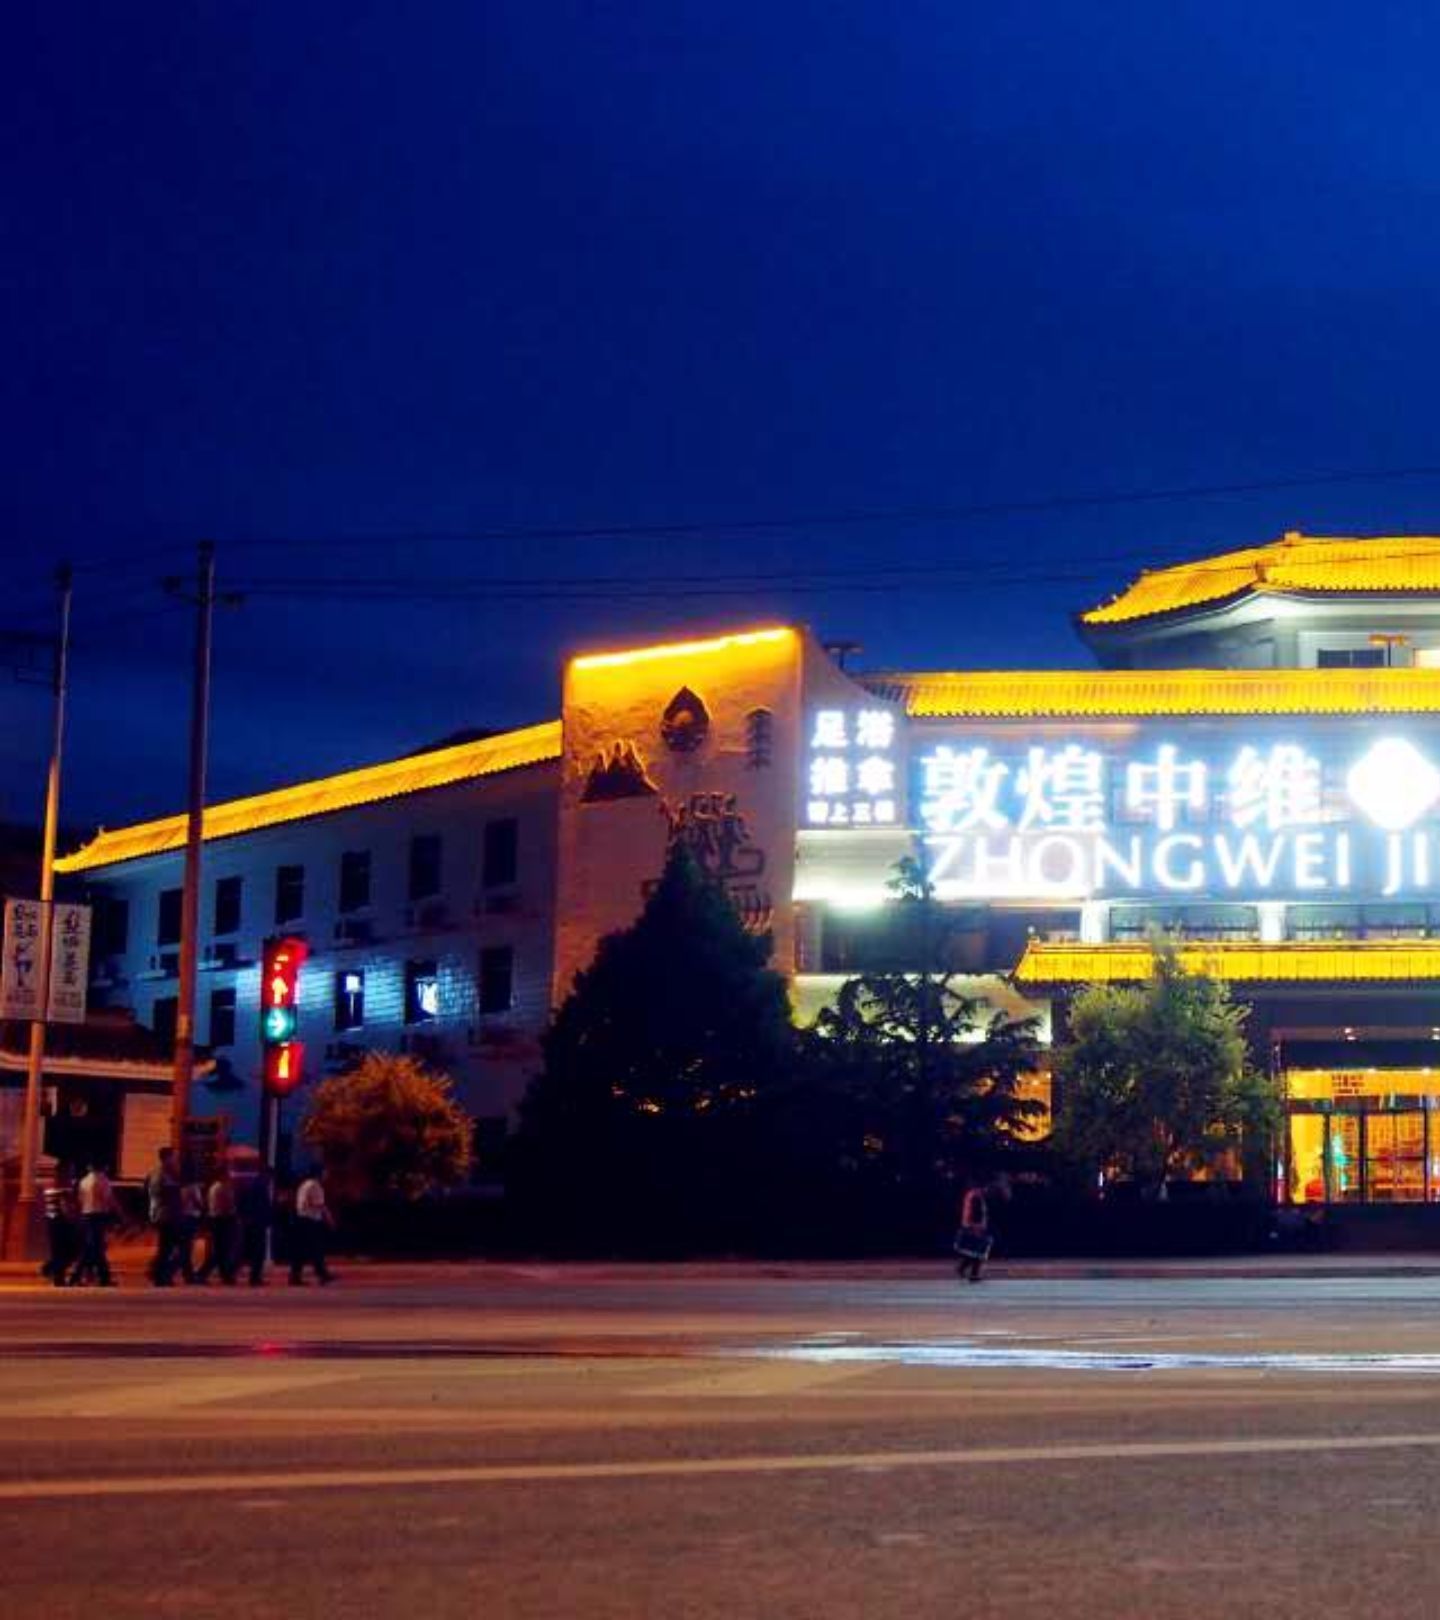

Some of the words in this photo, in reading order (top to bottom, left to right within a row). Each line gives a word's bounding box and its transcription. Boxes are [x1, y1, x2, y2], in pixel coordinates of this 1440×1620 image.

[921, 744, 1322, 833] 敦煌中维
[926, 833, 1350, 890] ZHONGWEI
